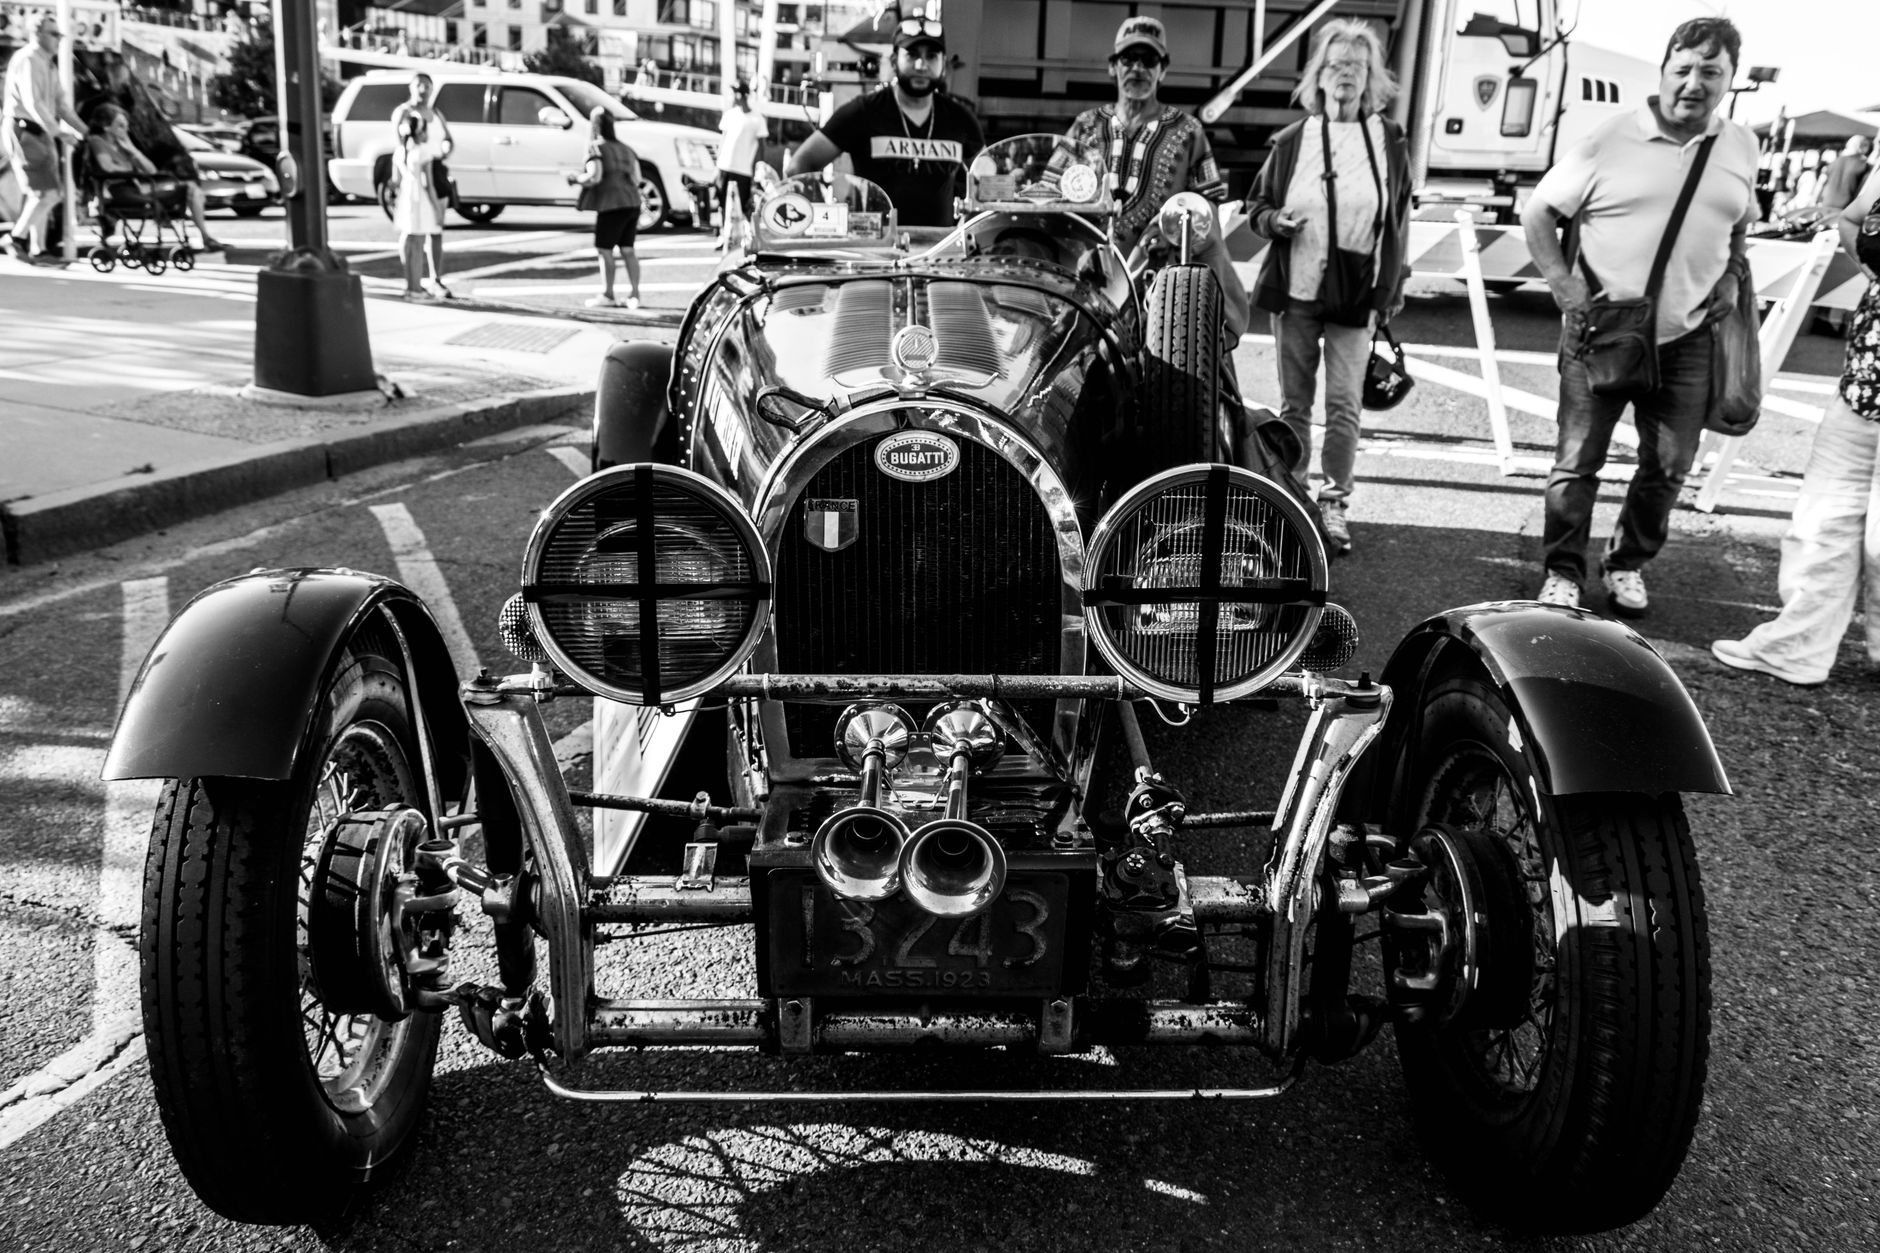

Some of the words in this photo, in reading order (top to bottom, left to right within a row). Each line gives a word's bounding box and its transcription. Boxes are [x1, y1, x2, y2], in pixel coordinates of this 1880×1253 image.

[1123, 22, 1162, 38] ARMY
[885, 139, 957, 157] ARMANI
[822, 212, 829, 221] 4
[890, 451, 945, 464] BUGATTI
[801, 885, 1049, 968] 13243
